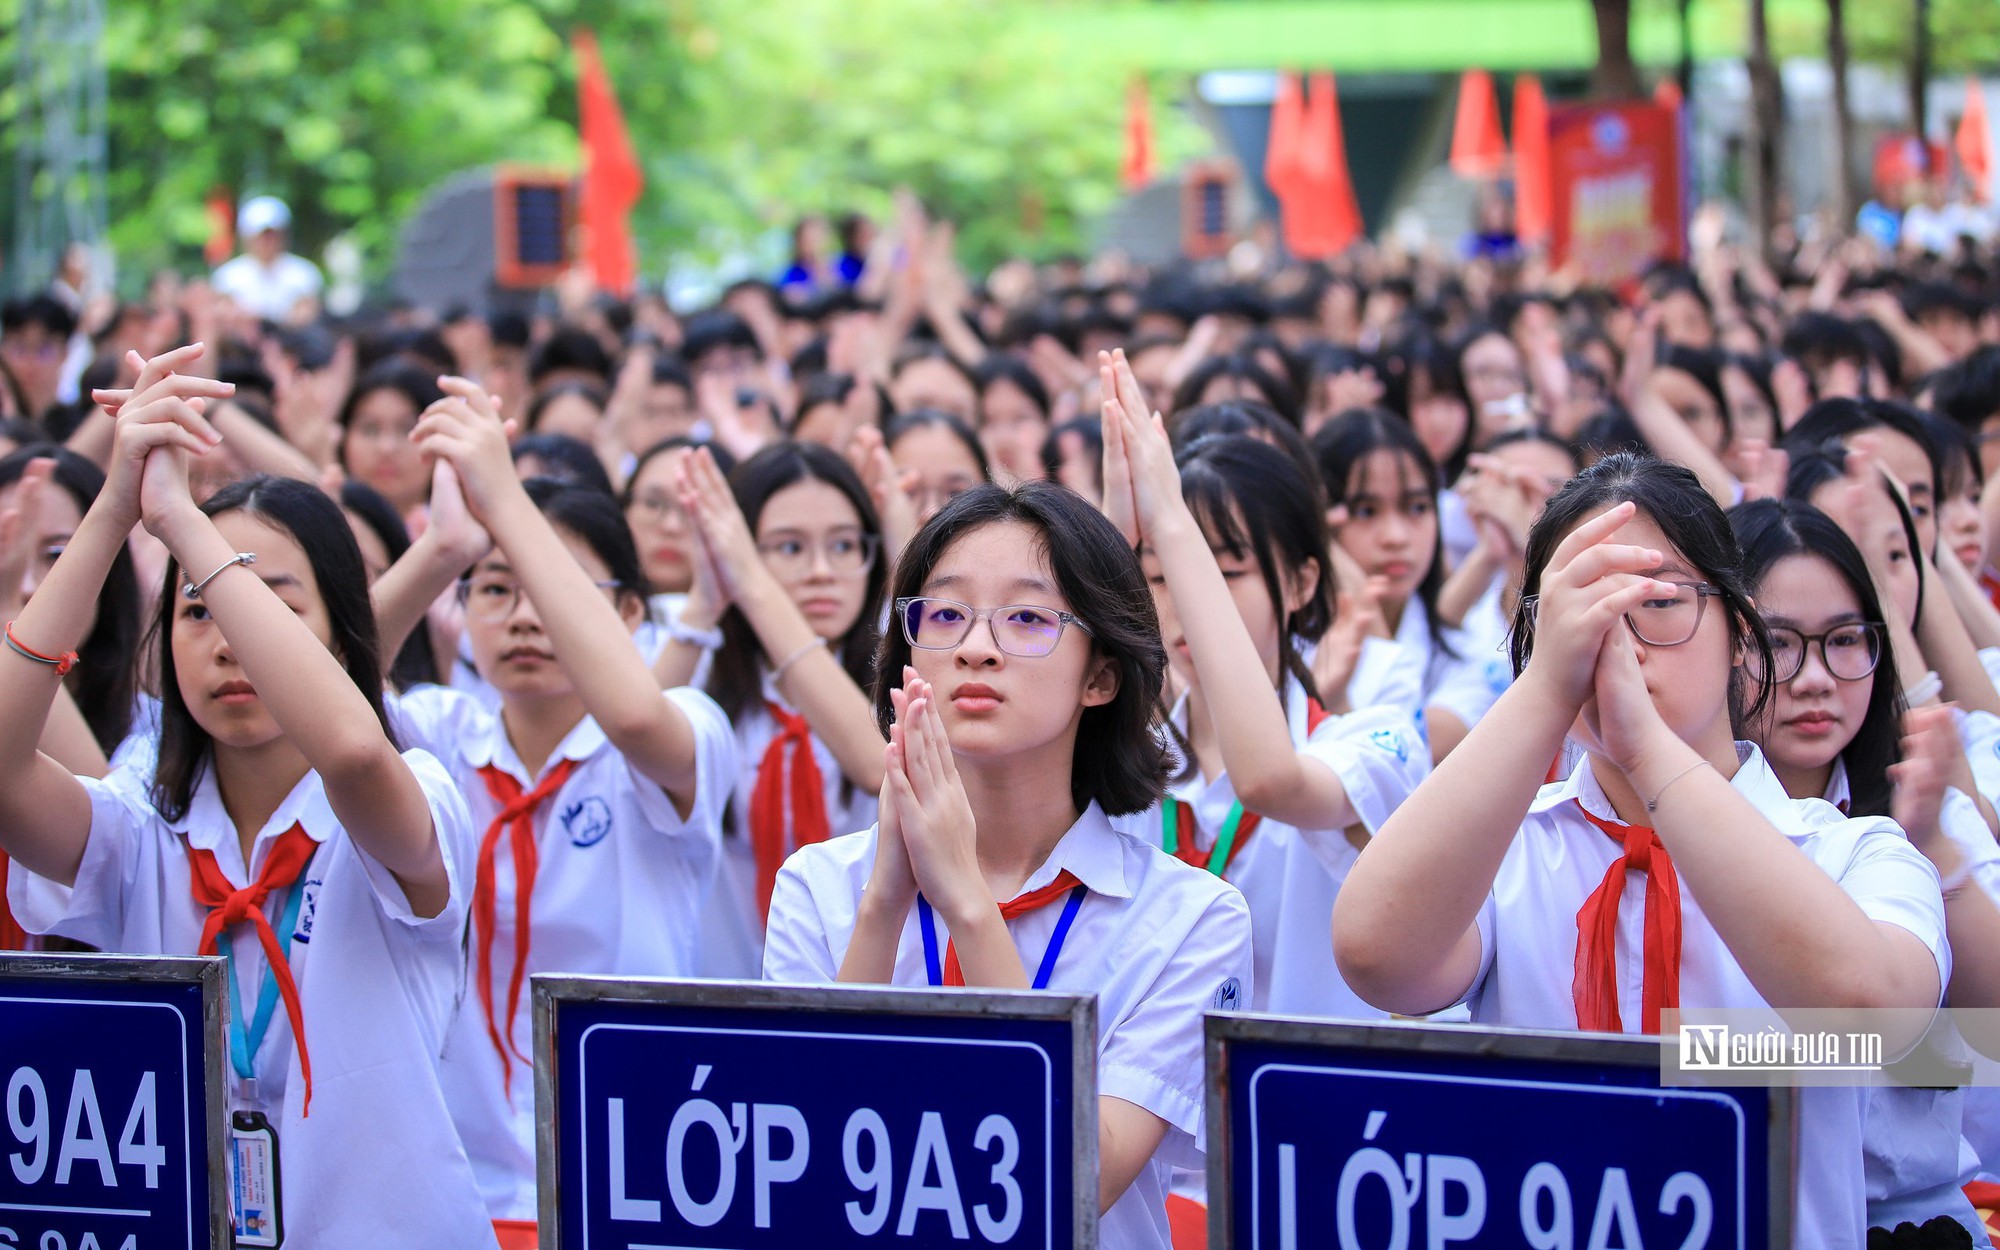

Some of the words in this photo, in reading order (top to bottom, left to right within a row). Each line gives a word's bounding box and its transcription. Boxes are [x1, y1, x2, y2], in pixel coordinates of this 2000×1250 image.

[6, 1066, 166, 1189] 9A4
[607, 1064, 810, 1228] LỚP
[842, 1107, 1023, 1244] 9A3
[1520, 1162, 1713, 1250] 9A2
